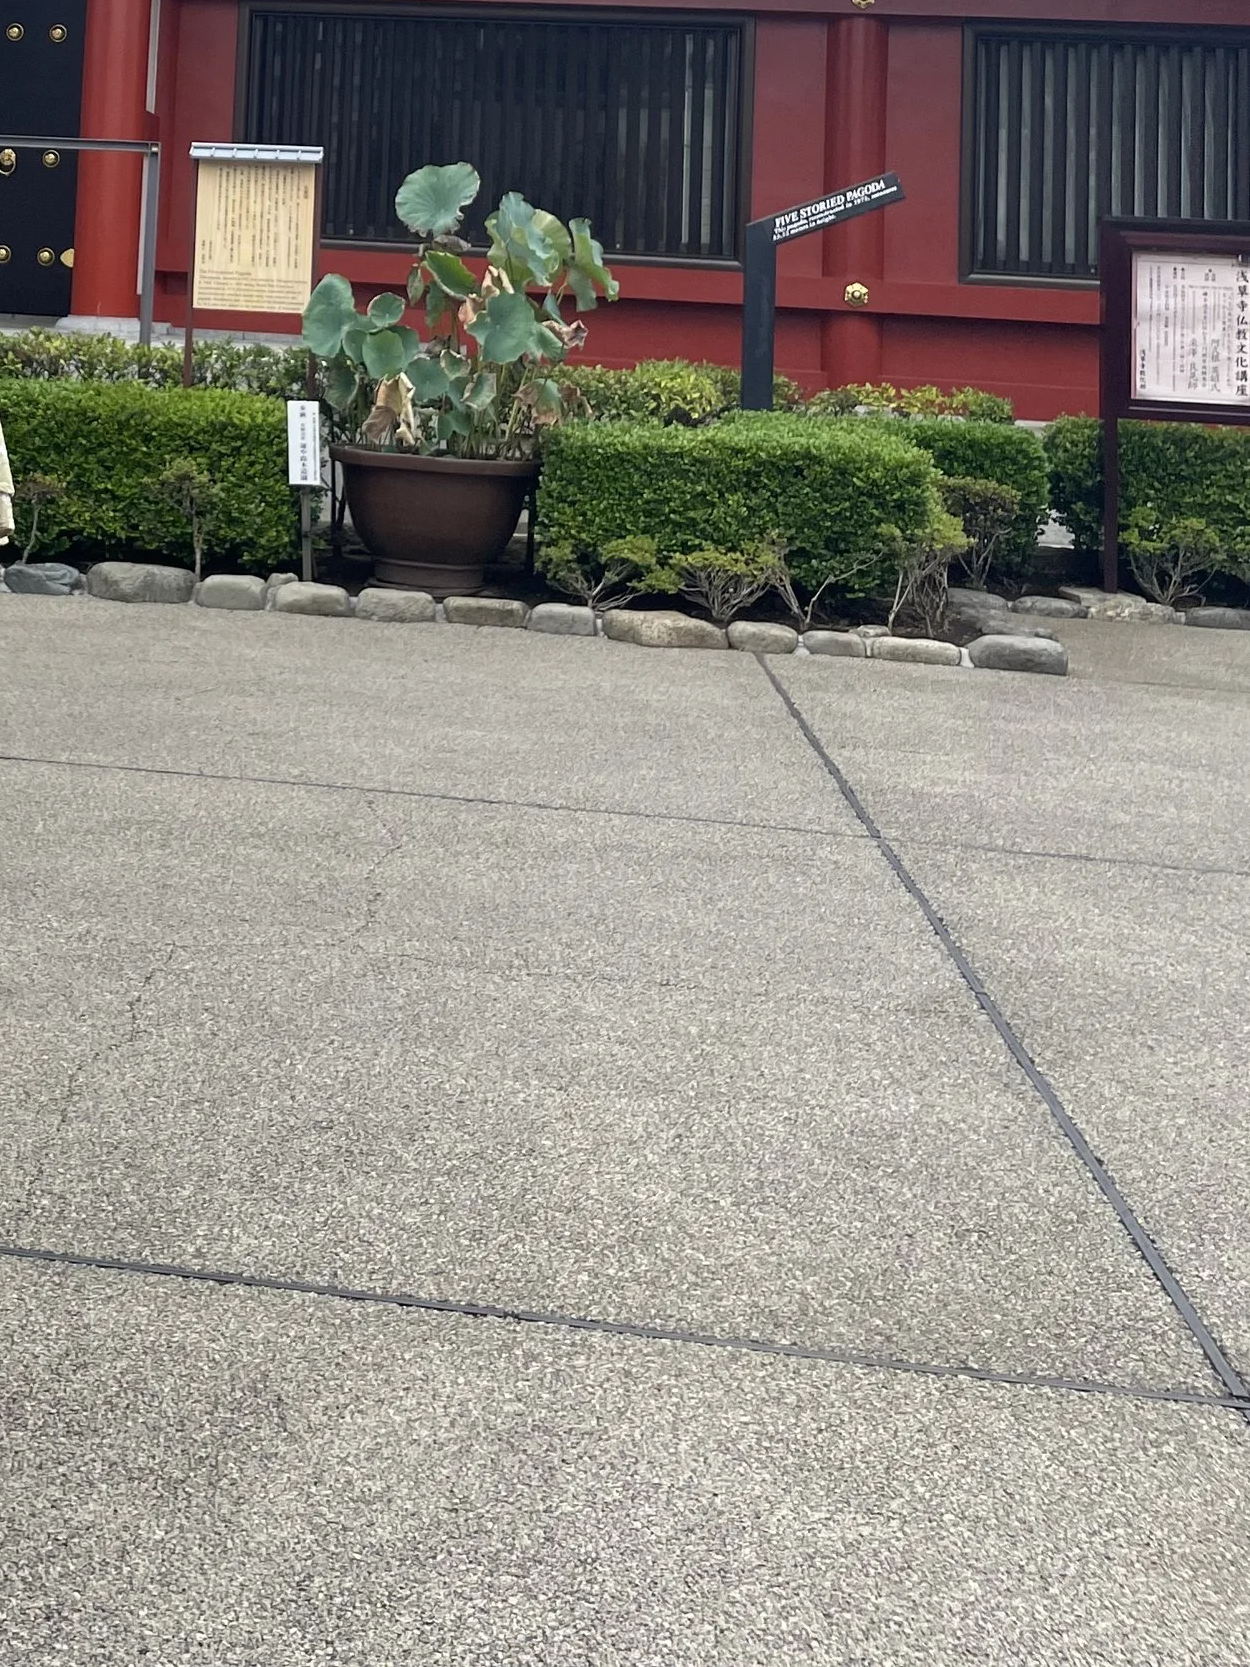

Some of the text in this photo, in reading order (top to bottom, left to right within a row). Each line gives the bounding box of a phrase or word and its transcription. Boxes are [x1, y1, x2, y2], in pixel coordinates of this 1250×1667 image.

[775, 179, 886, 227] FIVE STORIED PAGODA
[1235, 270, 1249, 396] 浅草寺仏教文化講座
